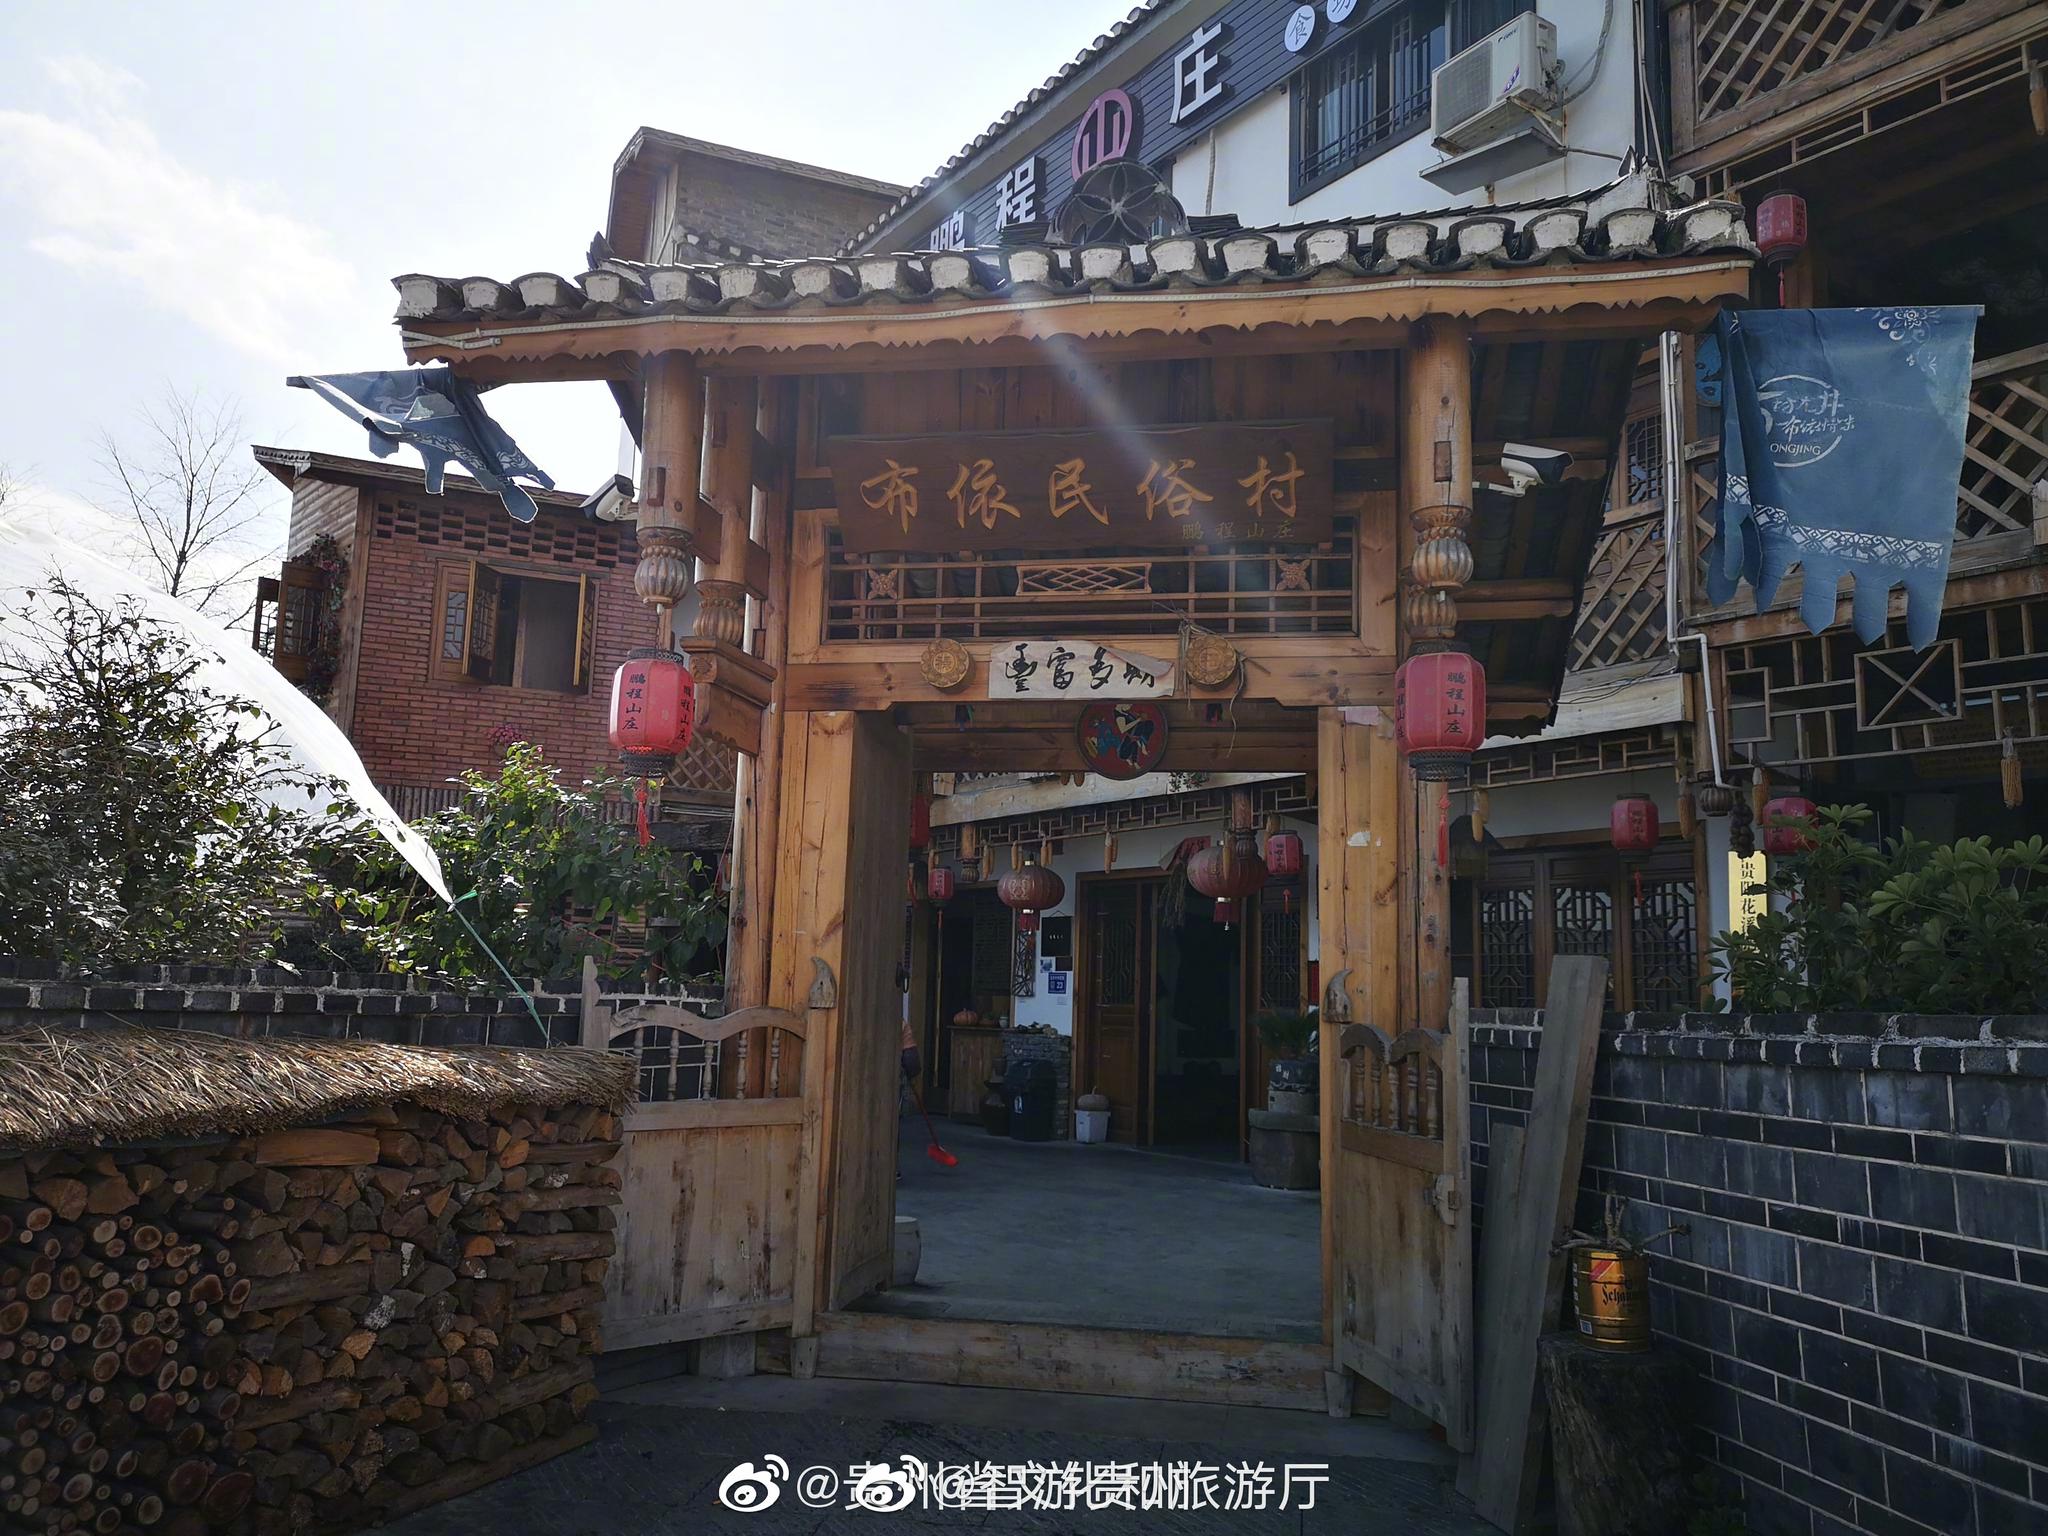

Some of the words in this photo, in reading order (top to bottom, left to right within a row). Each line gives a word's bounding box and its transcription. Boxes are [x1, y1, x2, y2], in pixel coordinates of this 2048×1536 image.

[860, 452, 1305, 535] 布依民俗村
